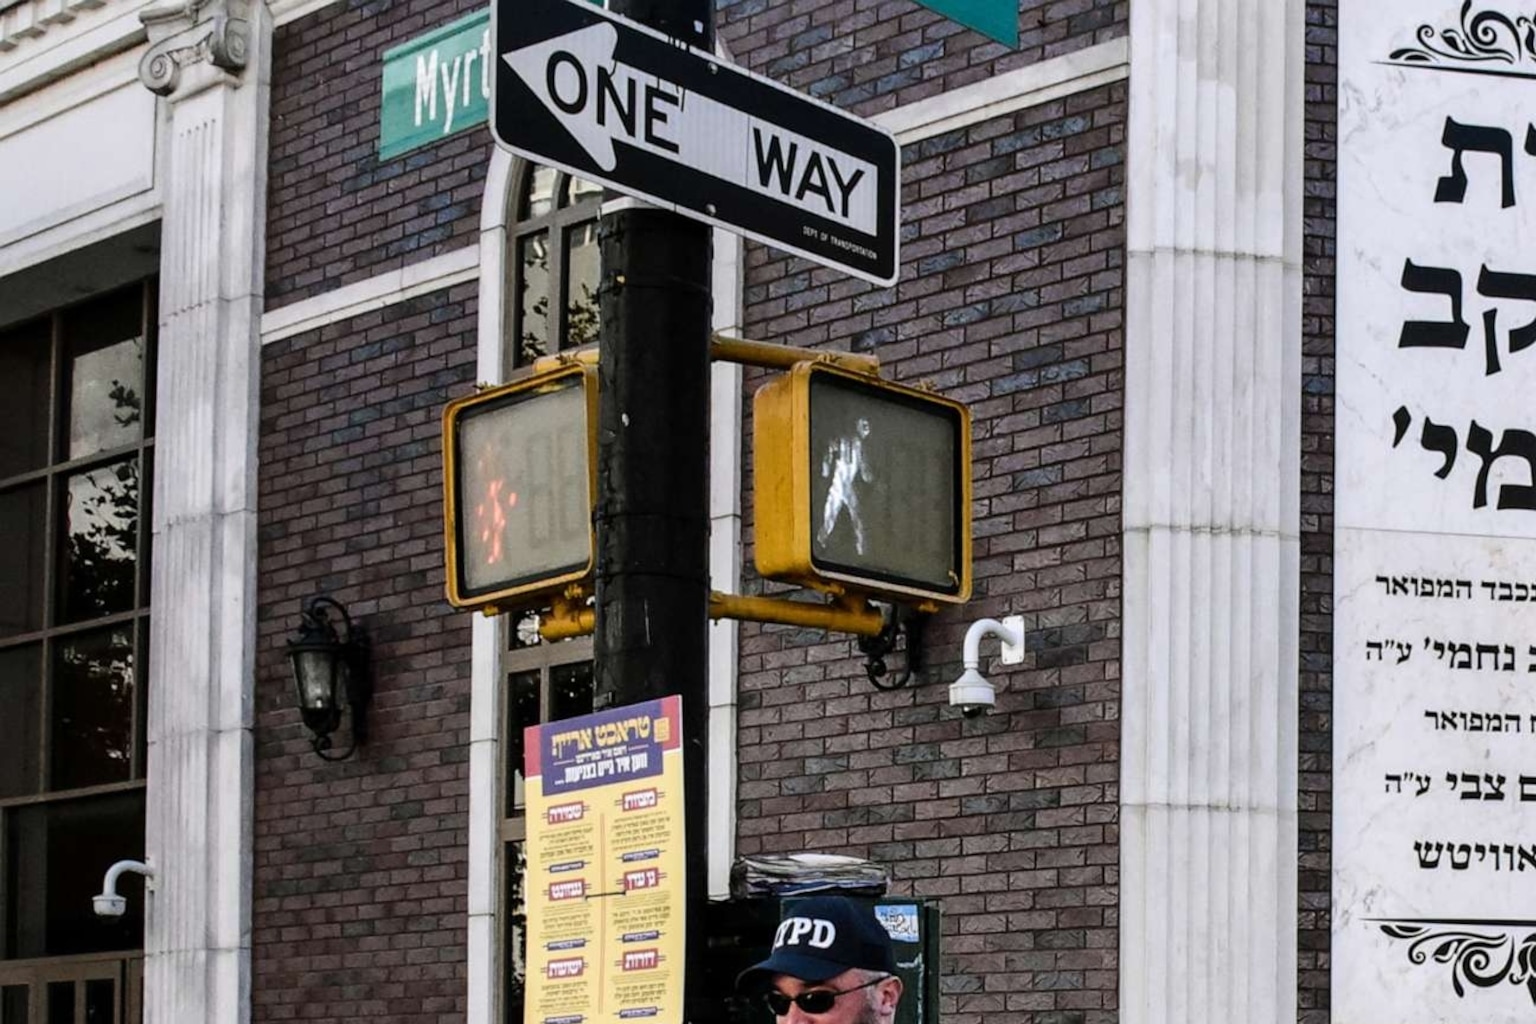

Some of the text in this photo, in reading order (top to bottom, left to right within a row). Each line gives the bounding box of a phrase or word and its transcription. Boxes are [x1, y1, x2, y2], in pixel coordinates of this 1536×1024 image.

[414, 30, 492, 134] Myrt
[545, 49, 865, 219] ONE WAY
[1375, 574, 1473, 600] המפואר
[1365, 639, 1413, 665] ע"ה
[1424, 709, 1521, 733] המפואר
[1384, 771, 1432, 797] ע"ה
[1445, 771, 1507, 802] צבי
